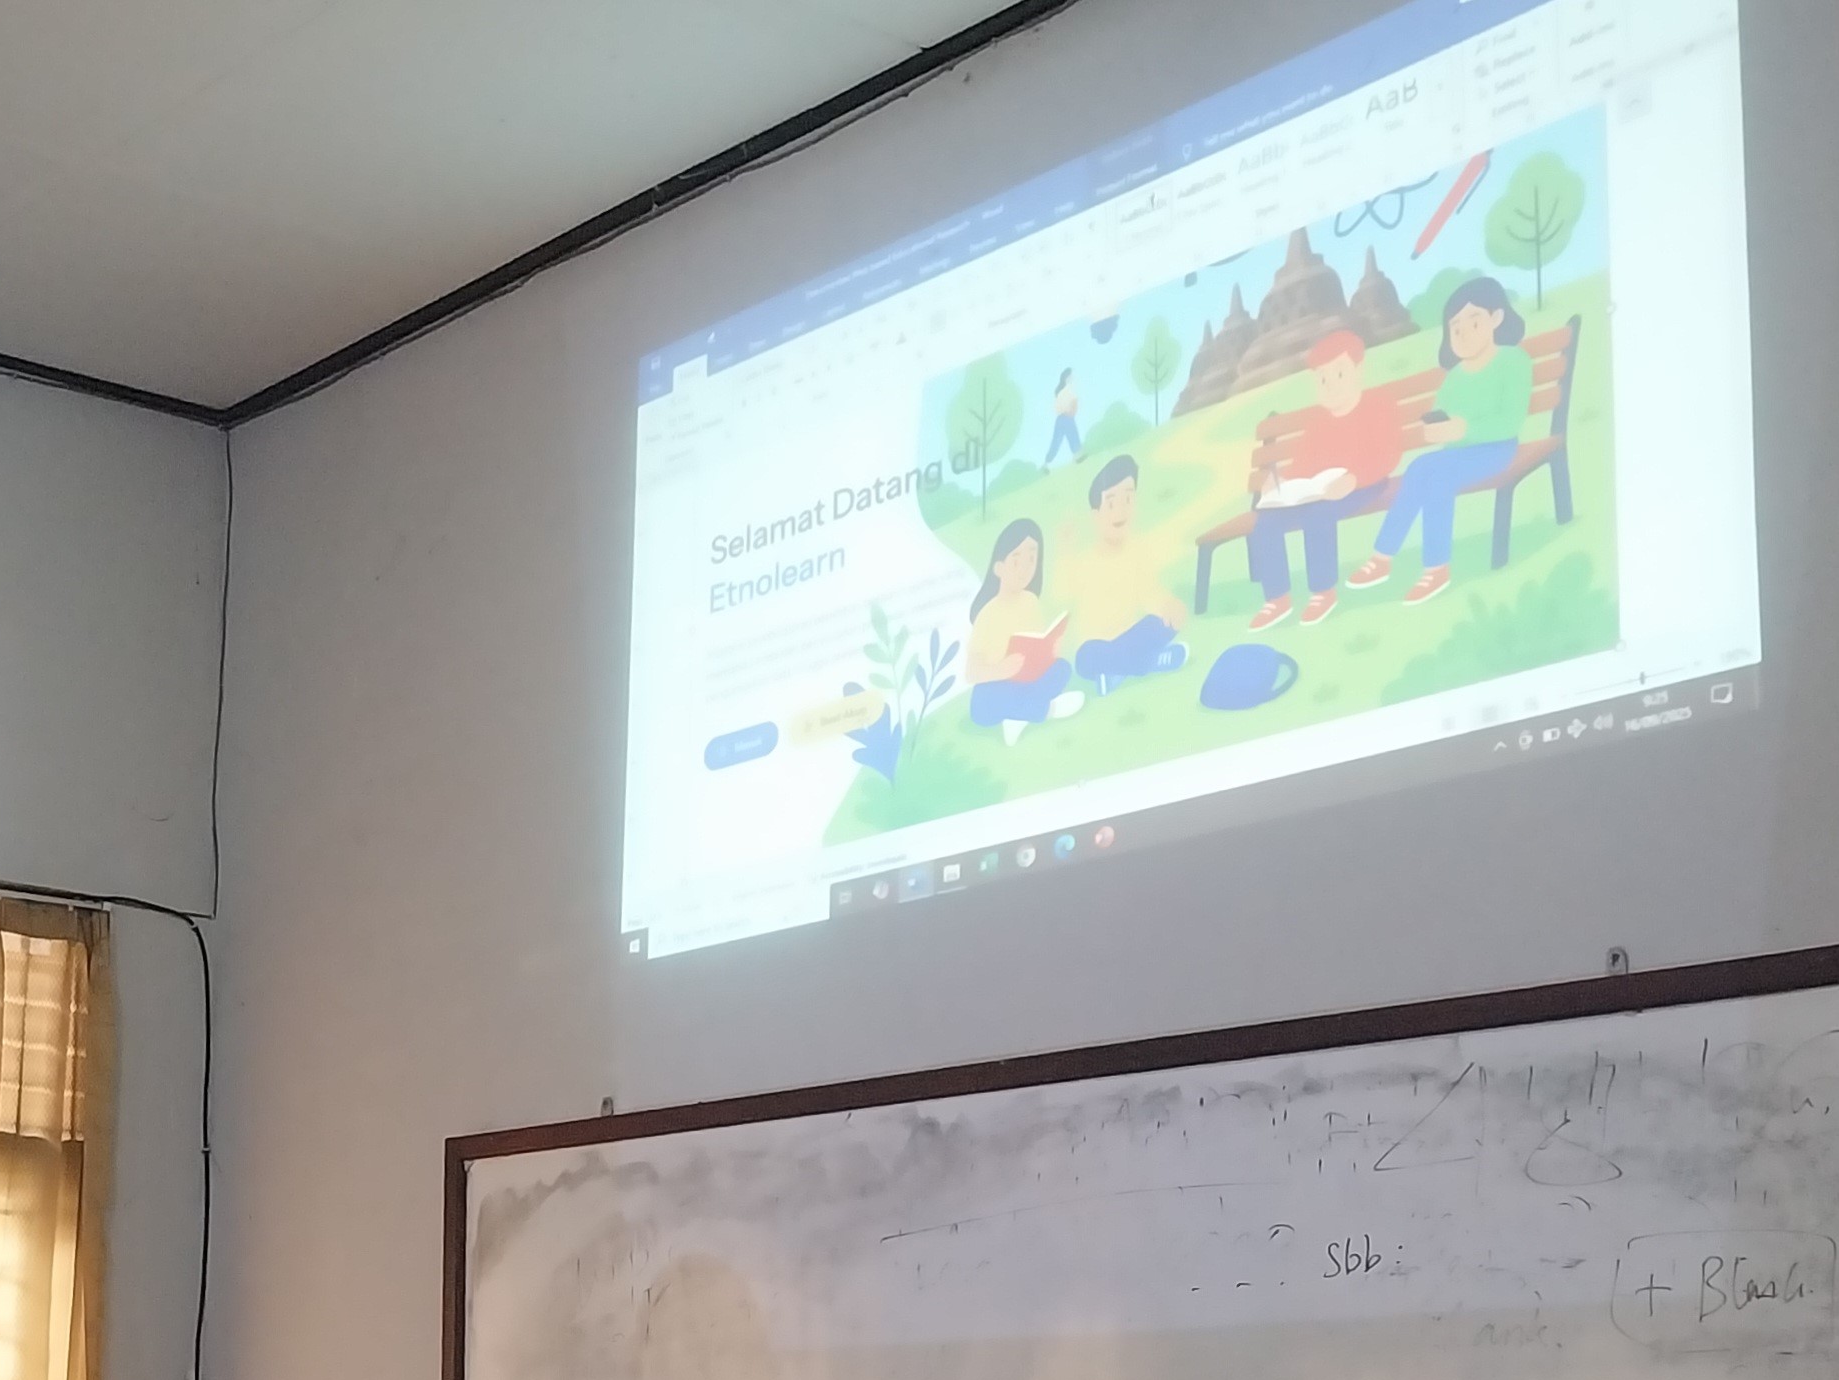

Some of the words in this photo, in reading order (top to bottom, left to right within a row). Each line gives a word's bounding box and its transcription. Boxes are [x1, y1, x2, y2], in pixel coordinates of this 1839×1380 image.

[710, 500, 826, 565] Selamat
[832, 459, 944, 521] Datang
[951, 437, 981, 476] di
[709, 547, 847, 614] Etnolearn
